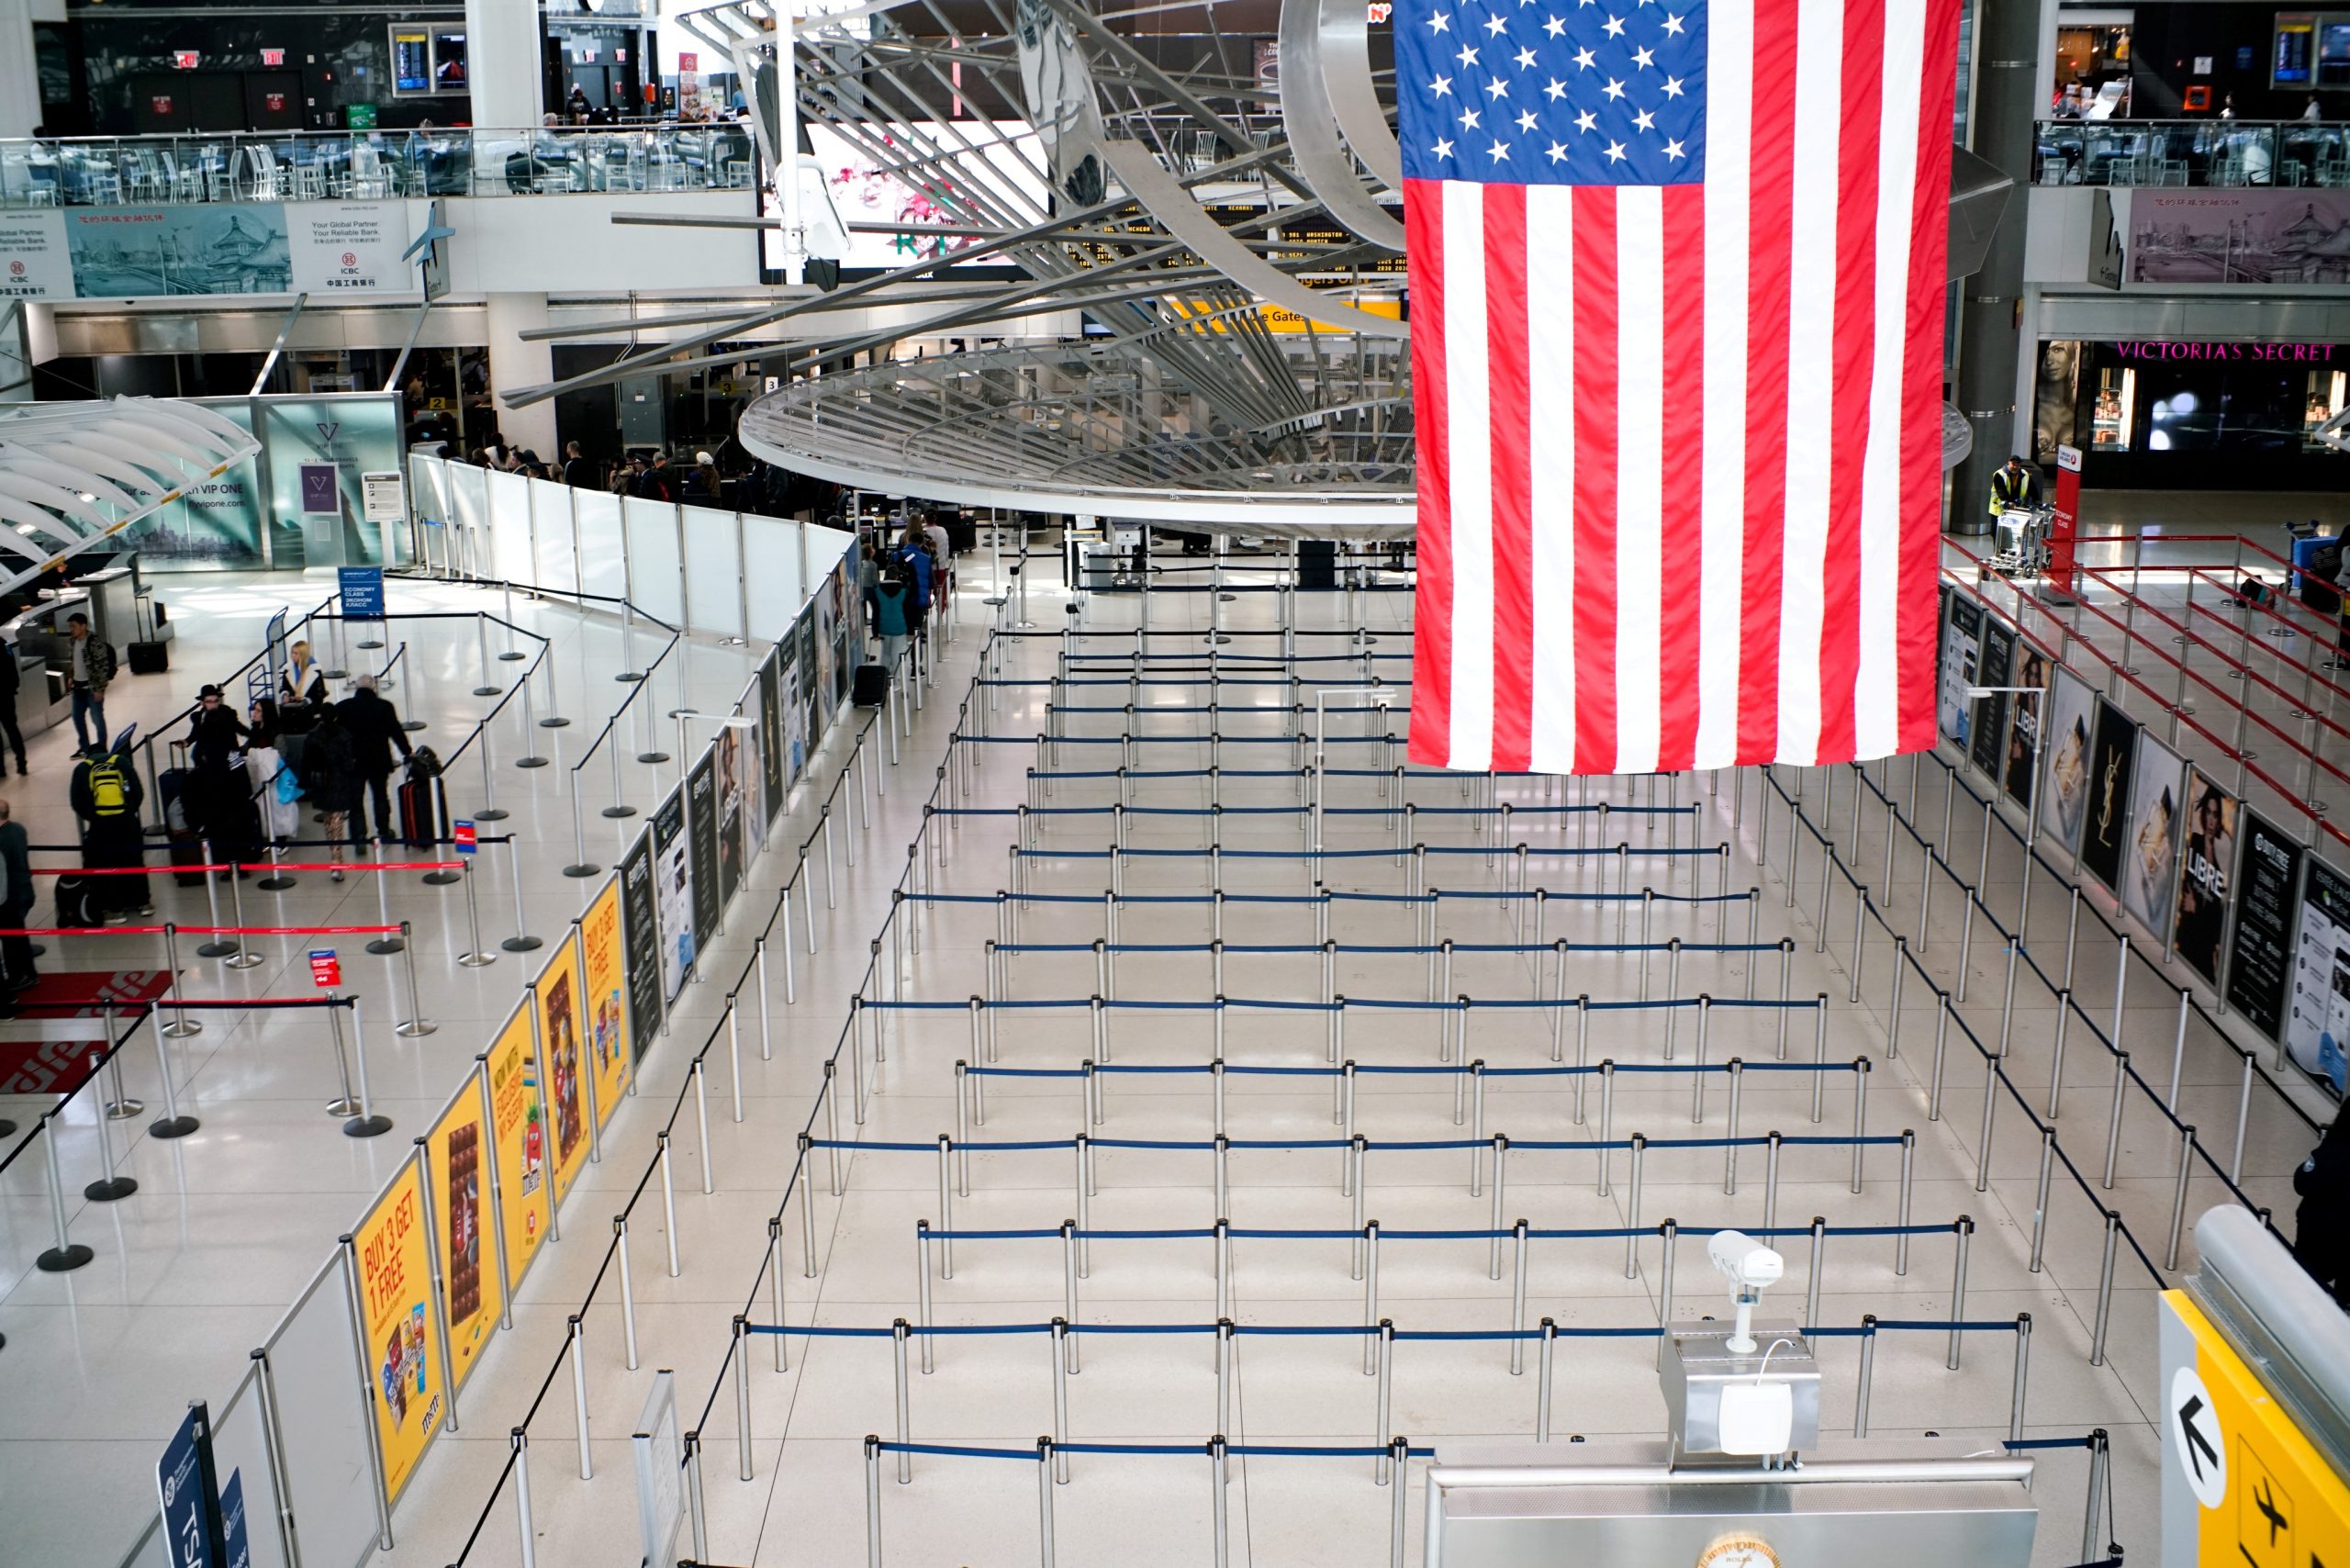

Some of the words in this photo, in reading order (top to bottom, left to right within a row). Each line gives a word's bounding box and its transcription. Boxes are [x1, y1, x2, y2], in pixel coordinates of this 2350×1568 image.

[264, 51, 282, 64] EXIT
[1272, 311, 1305, 321] Gates
[2117, 342, 2242, 359] VICTORIA'S
[2252, 343, 2334, 361] SECRET
[769, 381, 774, 389] 3
[433, 398, 442, 408] 2
[201, 485, 218, 494] VIP
[219, 484, 243, 494] ONE
[189, 499, 245, 509] flyvipone.com
[2055, 510, 2072, 521] ECONOMY
[2057, 519, 2069, 529] CLASS
[2016, 704, 2037, 740] LIBR
[2188, 847, 2224, 899] LIBRE
[364, 1232, 385, 1283] BUY
[386, 1216, 396, 1248] 3
[396, 1189, 415, 1238] GET
[369, 1282, 377, 1320] 1
[378, 1245, 405, 1305] FREE
